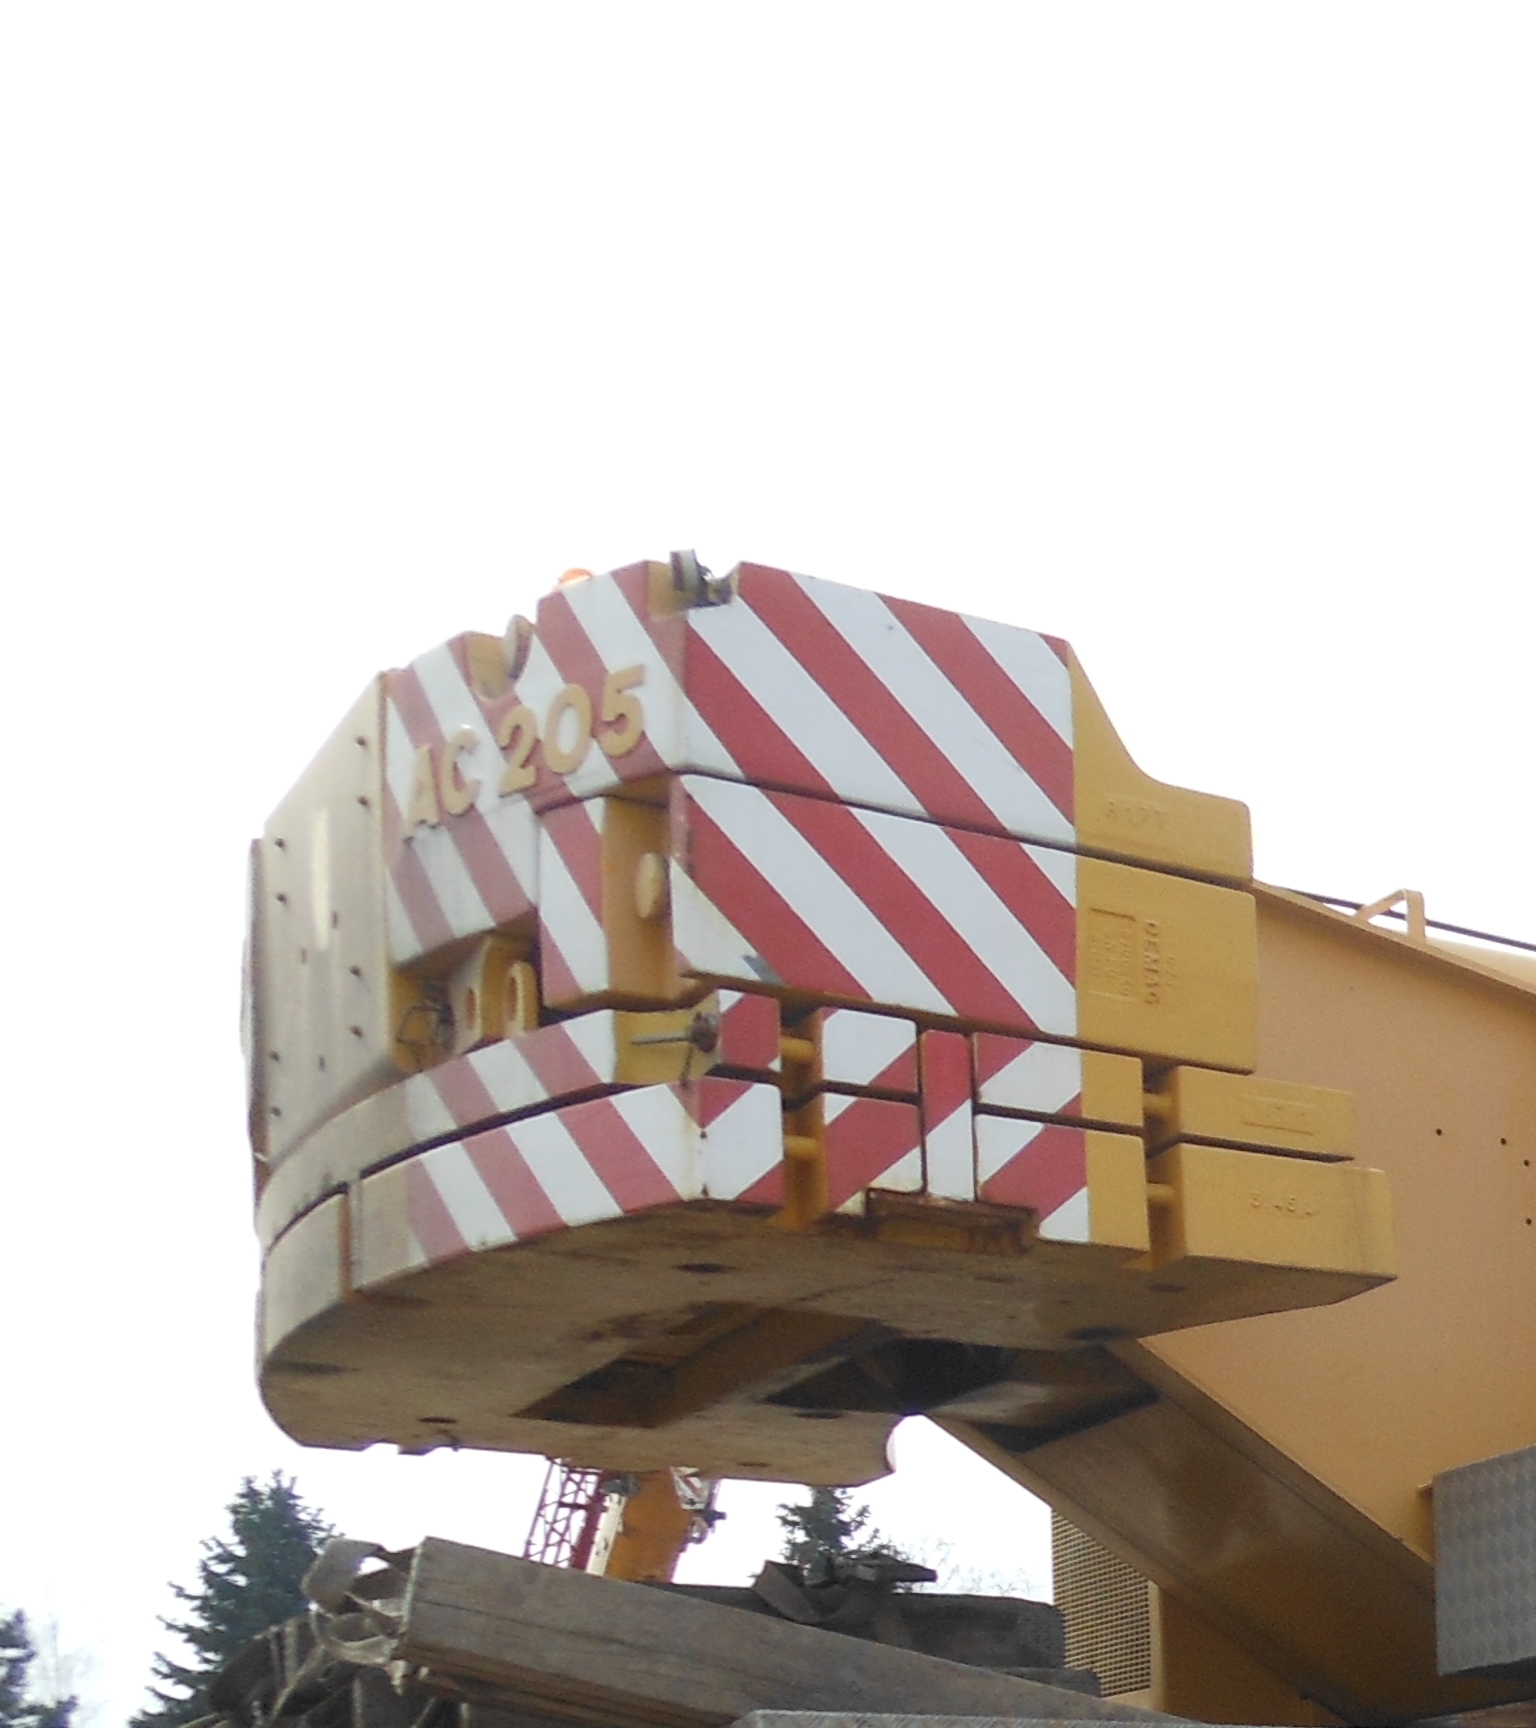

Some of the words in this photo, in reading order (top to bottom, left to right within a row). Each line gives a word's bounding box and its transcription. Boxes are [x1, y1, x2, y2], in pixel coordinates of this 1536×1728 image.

[403, 724, 479, 843] AC
[499, 664, 645, 797] 205
[1143, 919, 1161, 1005] DEMAG
